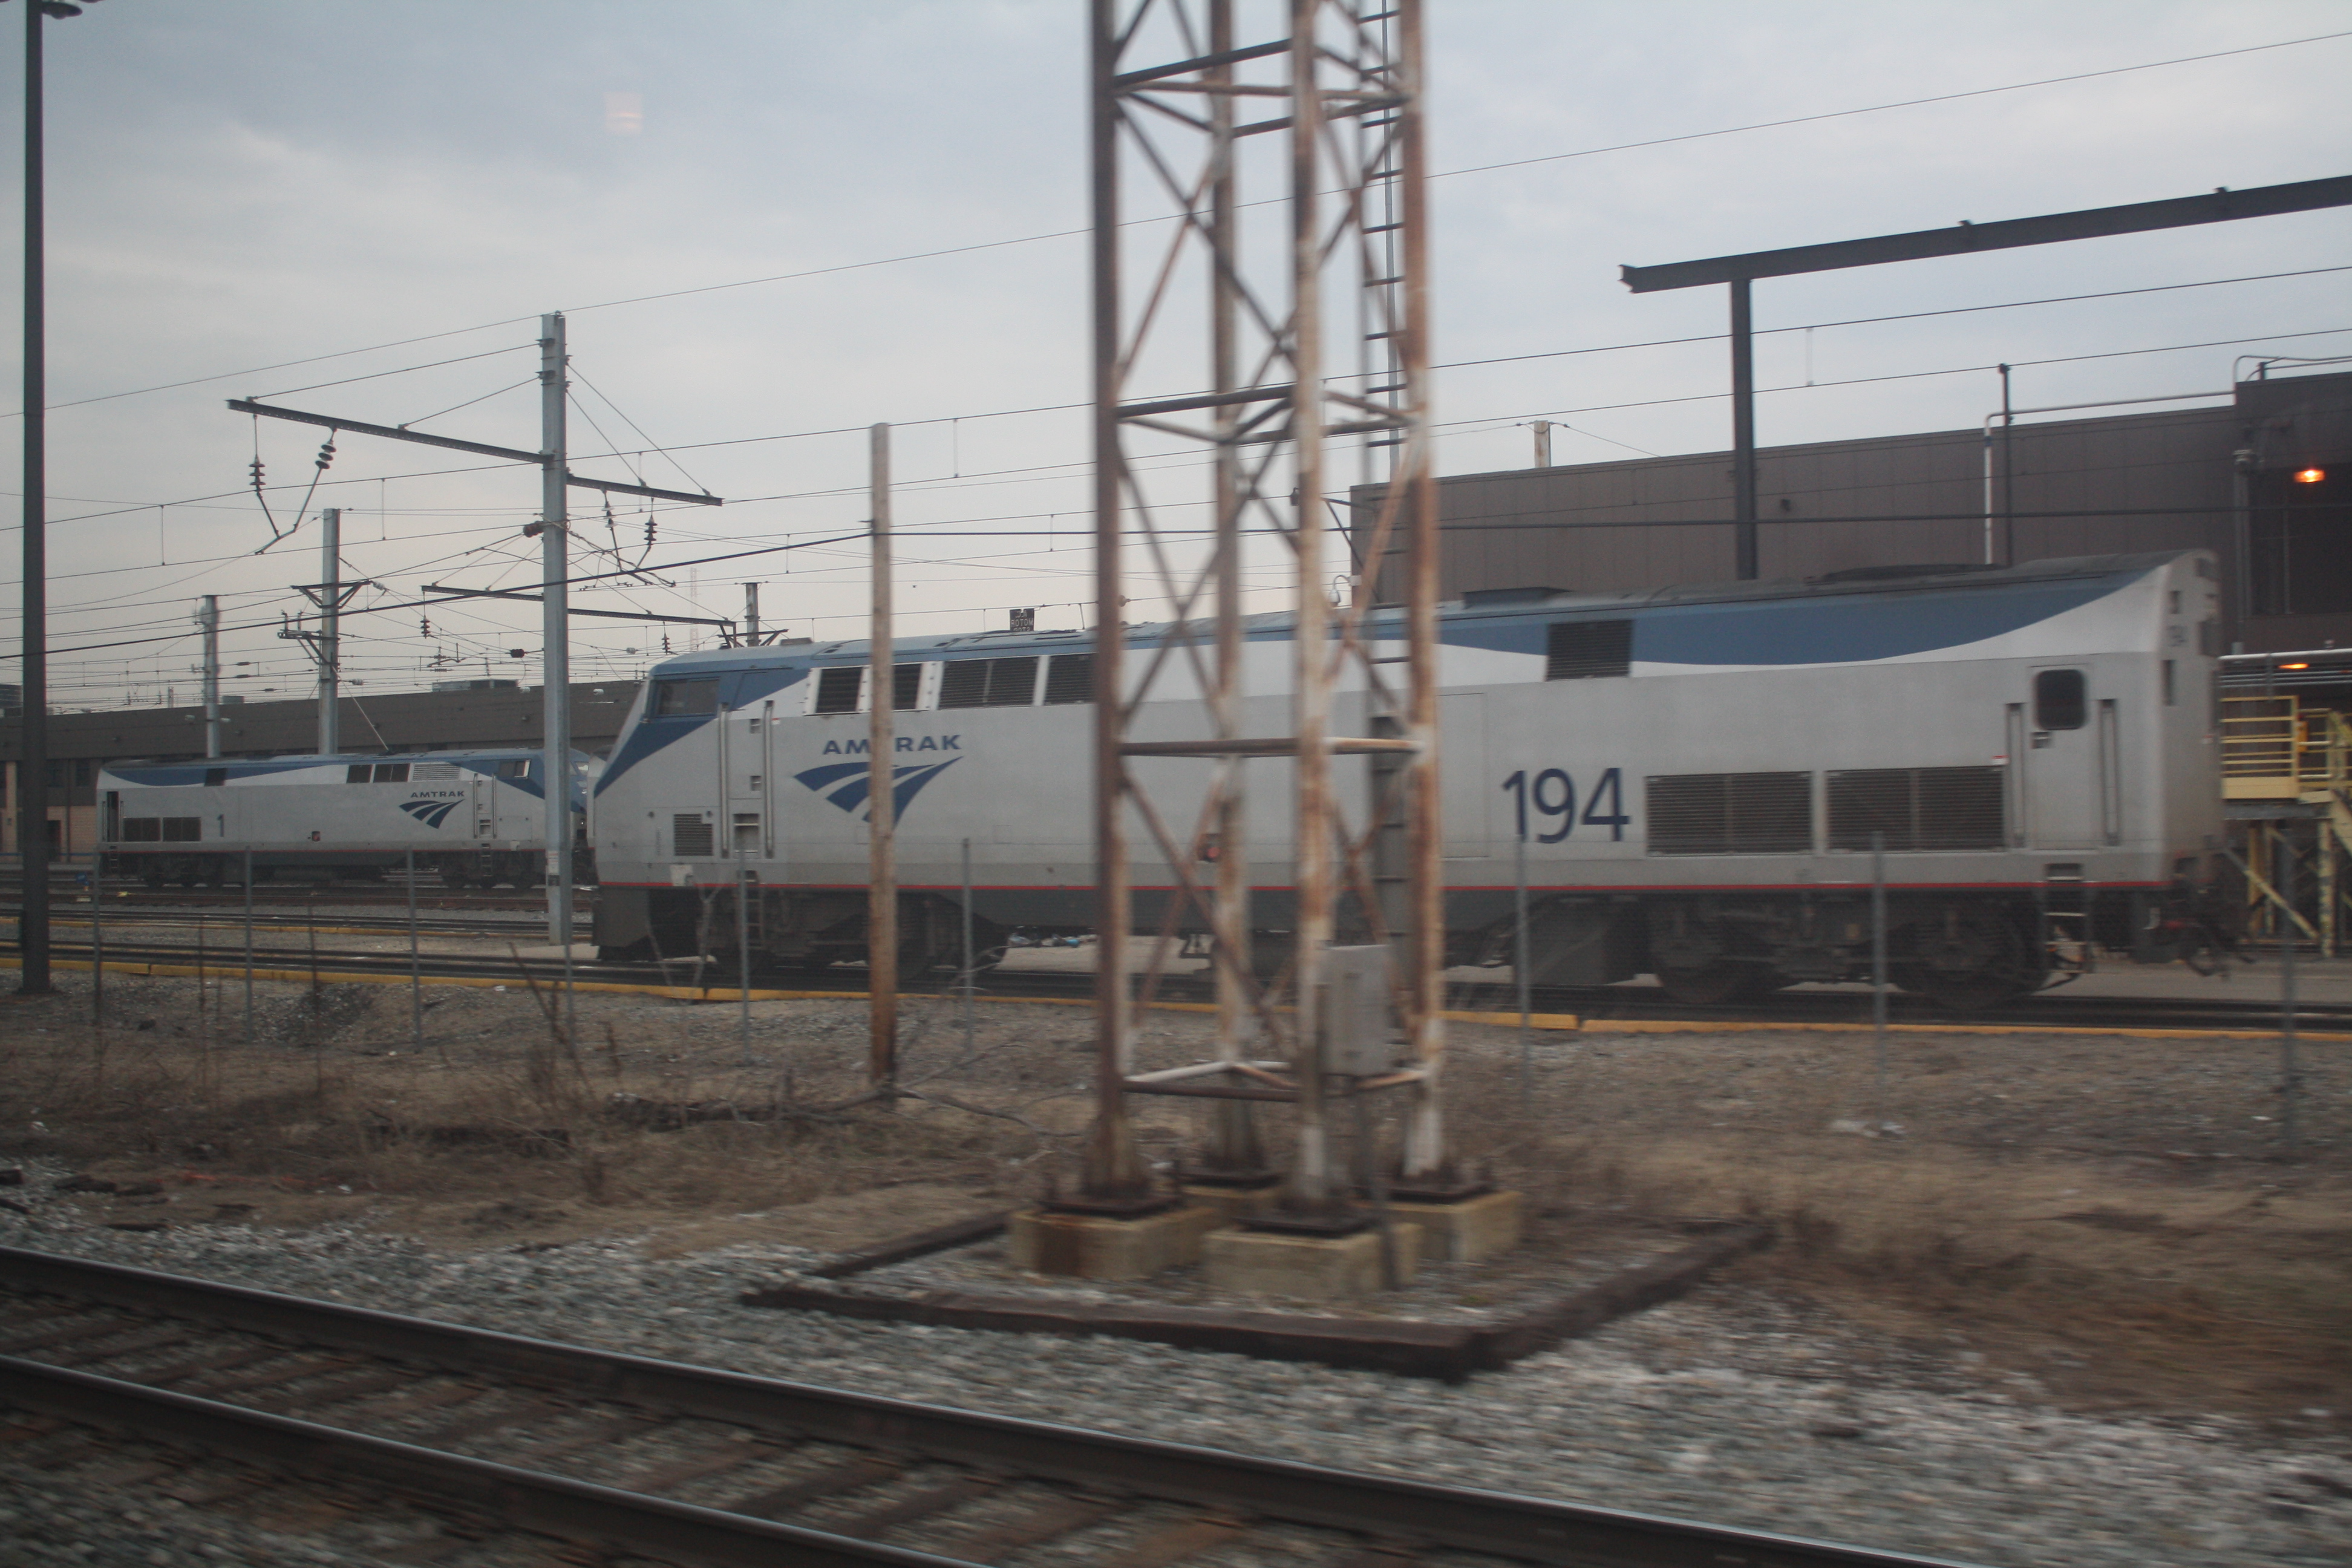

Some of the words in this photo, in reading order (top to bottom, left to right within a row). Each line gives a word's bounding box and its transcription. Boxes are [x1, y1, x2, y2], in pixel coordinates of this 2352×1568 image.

[822, 734, 962, 755] AMRAK
[1503, 768, 1630, 843] 194
[217, 814, 225, 837] 1
